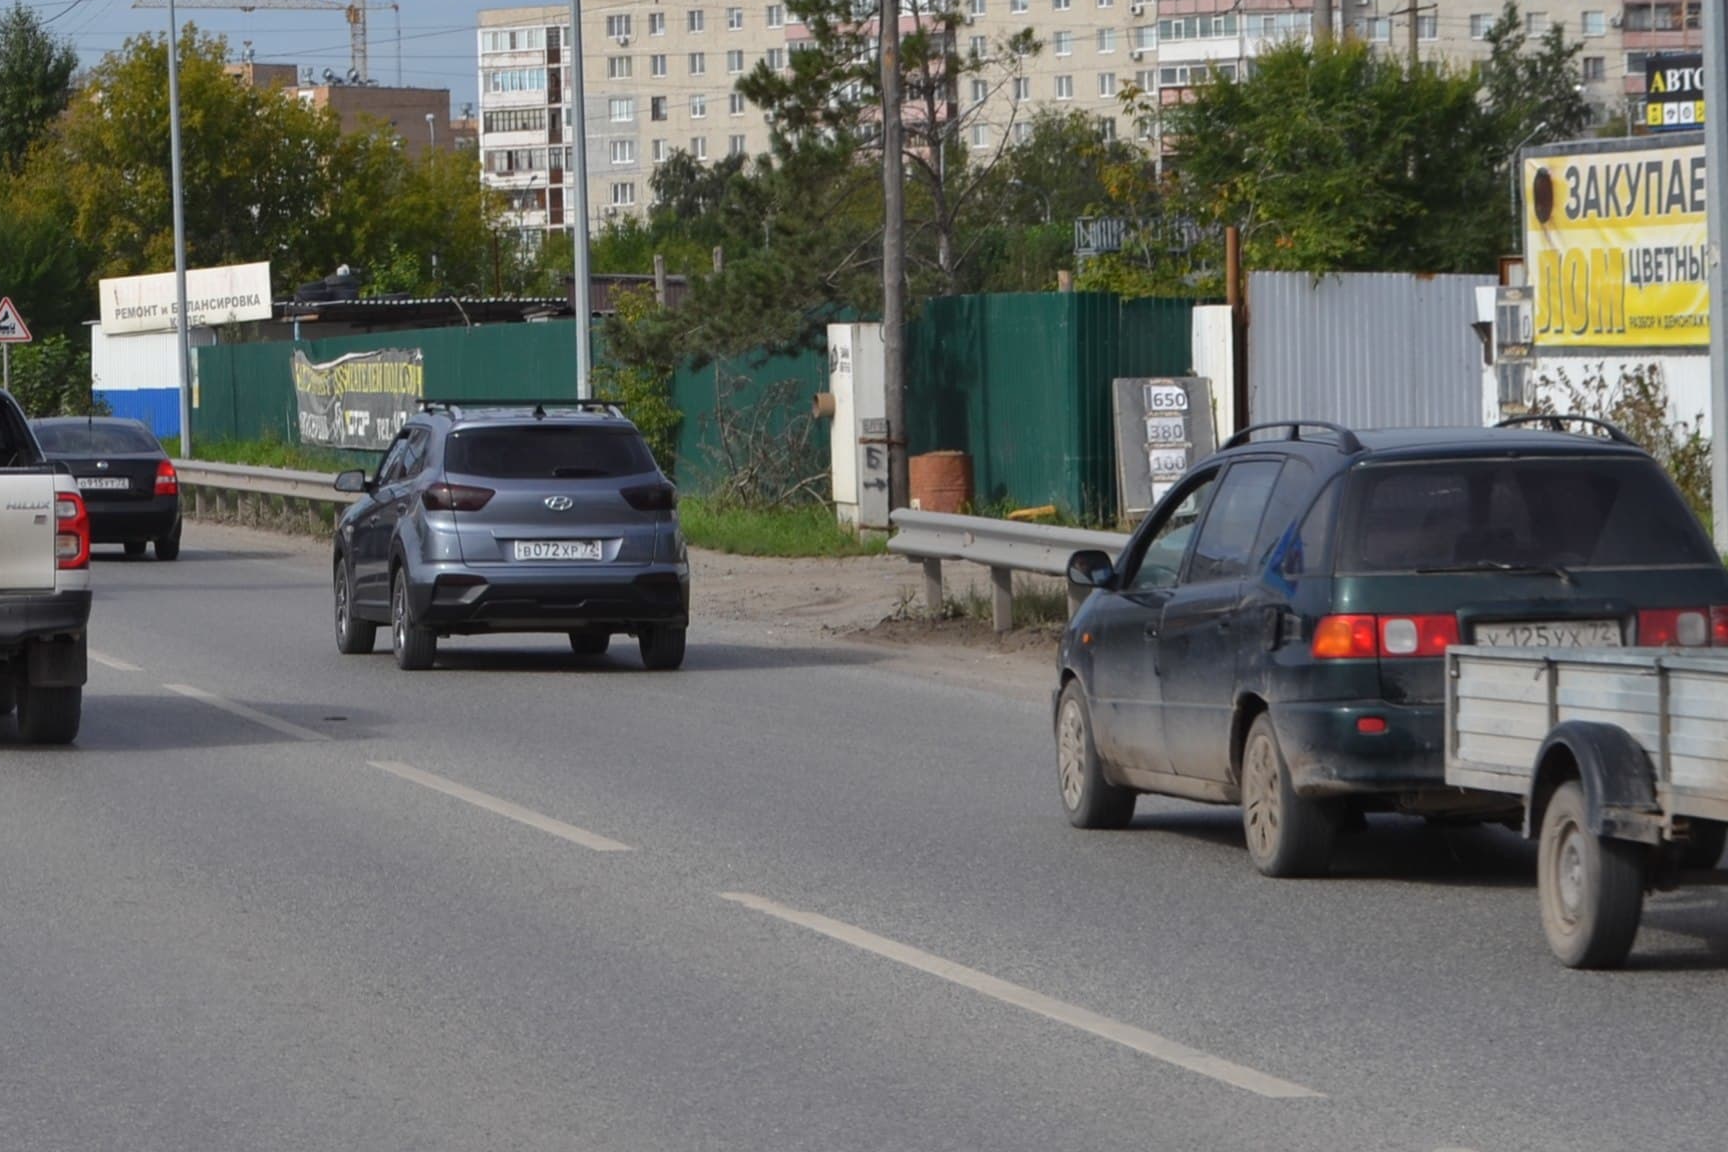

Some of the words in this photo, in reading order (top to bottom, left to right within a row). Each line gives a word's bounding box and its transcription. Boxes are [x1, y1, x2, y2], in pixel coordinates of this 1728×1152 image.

[1565, 157, 1705, 220] ЗАКУПАЕ
[1538, 248, 1626, 335] ЛОМ
[1629, 244, 1708, 291] ЦВЕТНЫ
[115, 305, 158, 320] РЕМОНТ
[171, 294, 261, 313] БЛАНСИРОВКА
[170, 315, 207, 328] КЛЕС
[1153, 393, 1186, 407] 650
[1150, 424, 1183, 440] 380
[1589, 623, 1612, 641] 72
